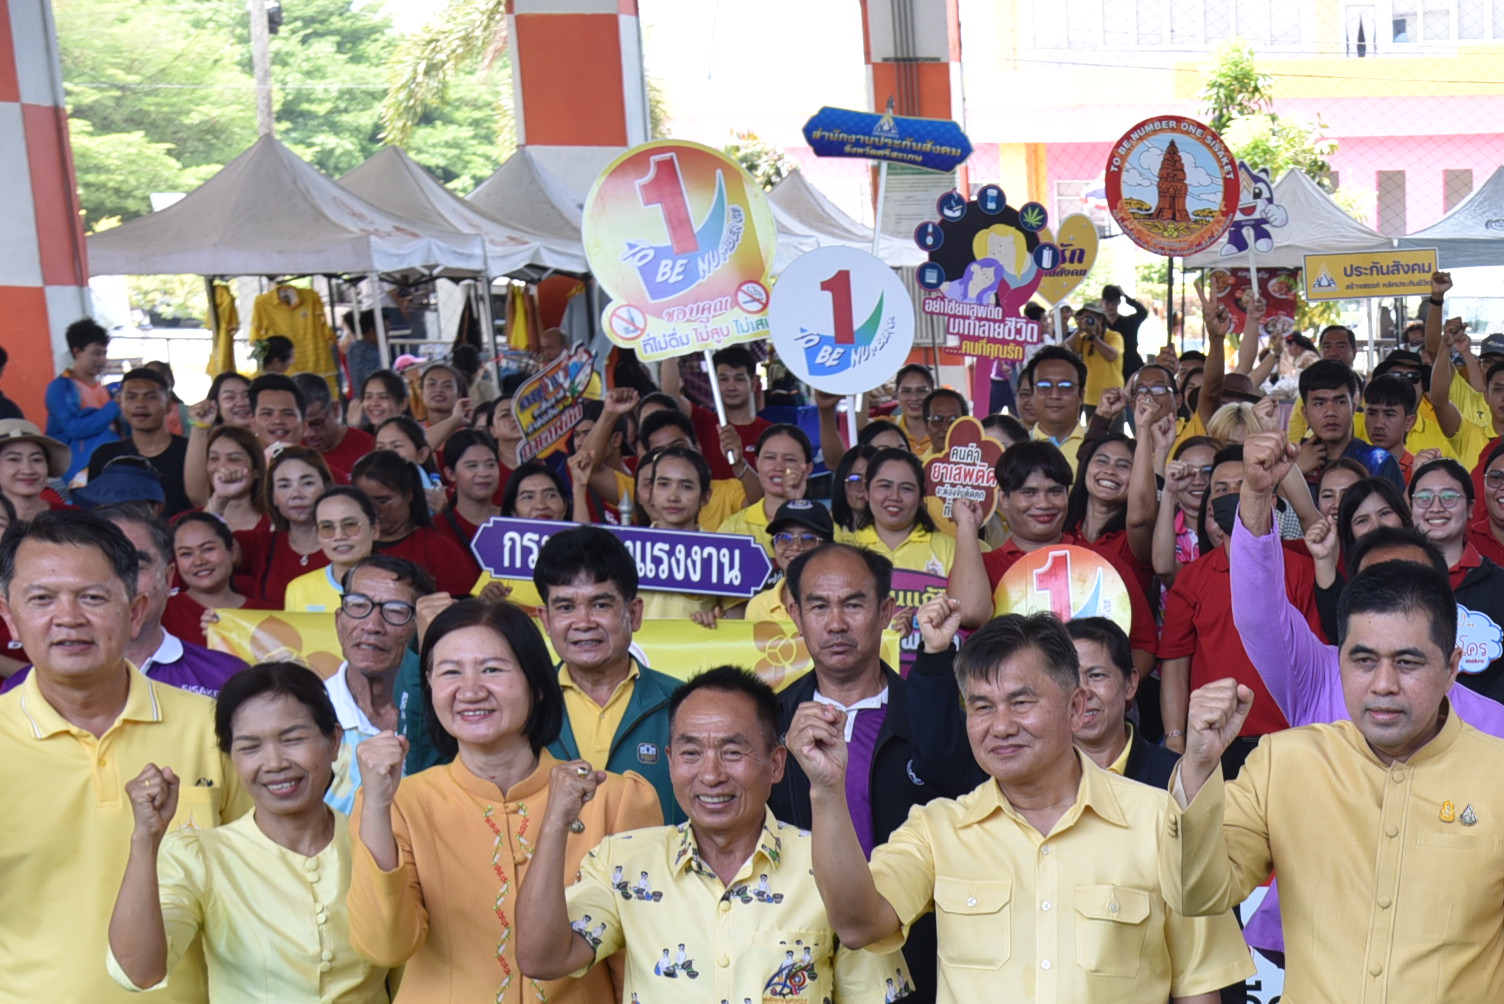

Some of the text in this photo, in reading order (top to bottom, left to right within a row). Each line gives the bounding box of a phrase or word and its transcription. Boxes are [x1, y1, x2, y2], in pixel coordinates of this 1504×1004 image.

[812, 128, 961, 157] สำนักงานประกันสังคม
[1110, 120, 1234, 180] TO BE NUMBER ONE SISAKET
[634, 152, 700, 255] 1
[655, 257, 690, 284] BE
[1343, 260, 1432, 278] ประกันสังคม
[662, 297, 732, 324] ขอบคุณ
[820, 270, 855, 344] 1
[694, 325, 731, 344] ไม่สูบ
[949, 315, 1039, 343] มาทำลายชีวิต
[815, 344, 845, 367] BE
[951, 443, 981, 462] คนค้า
[932, 463, 996, 486] ยาเสพติด
